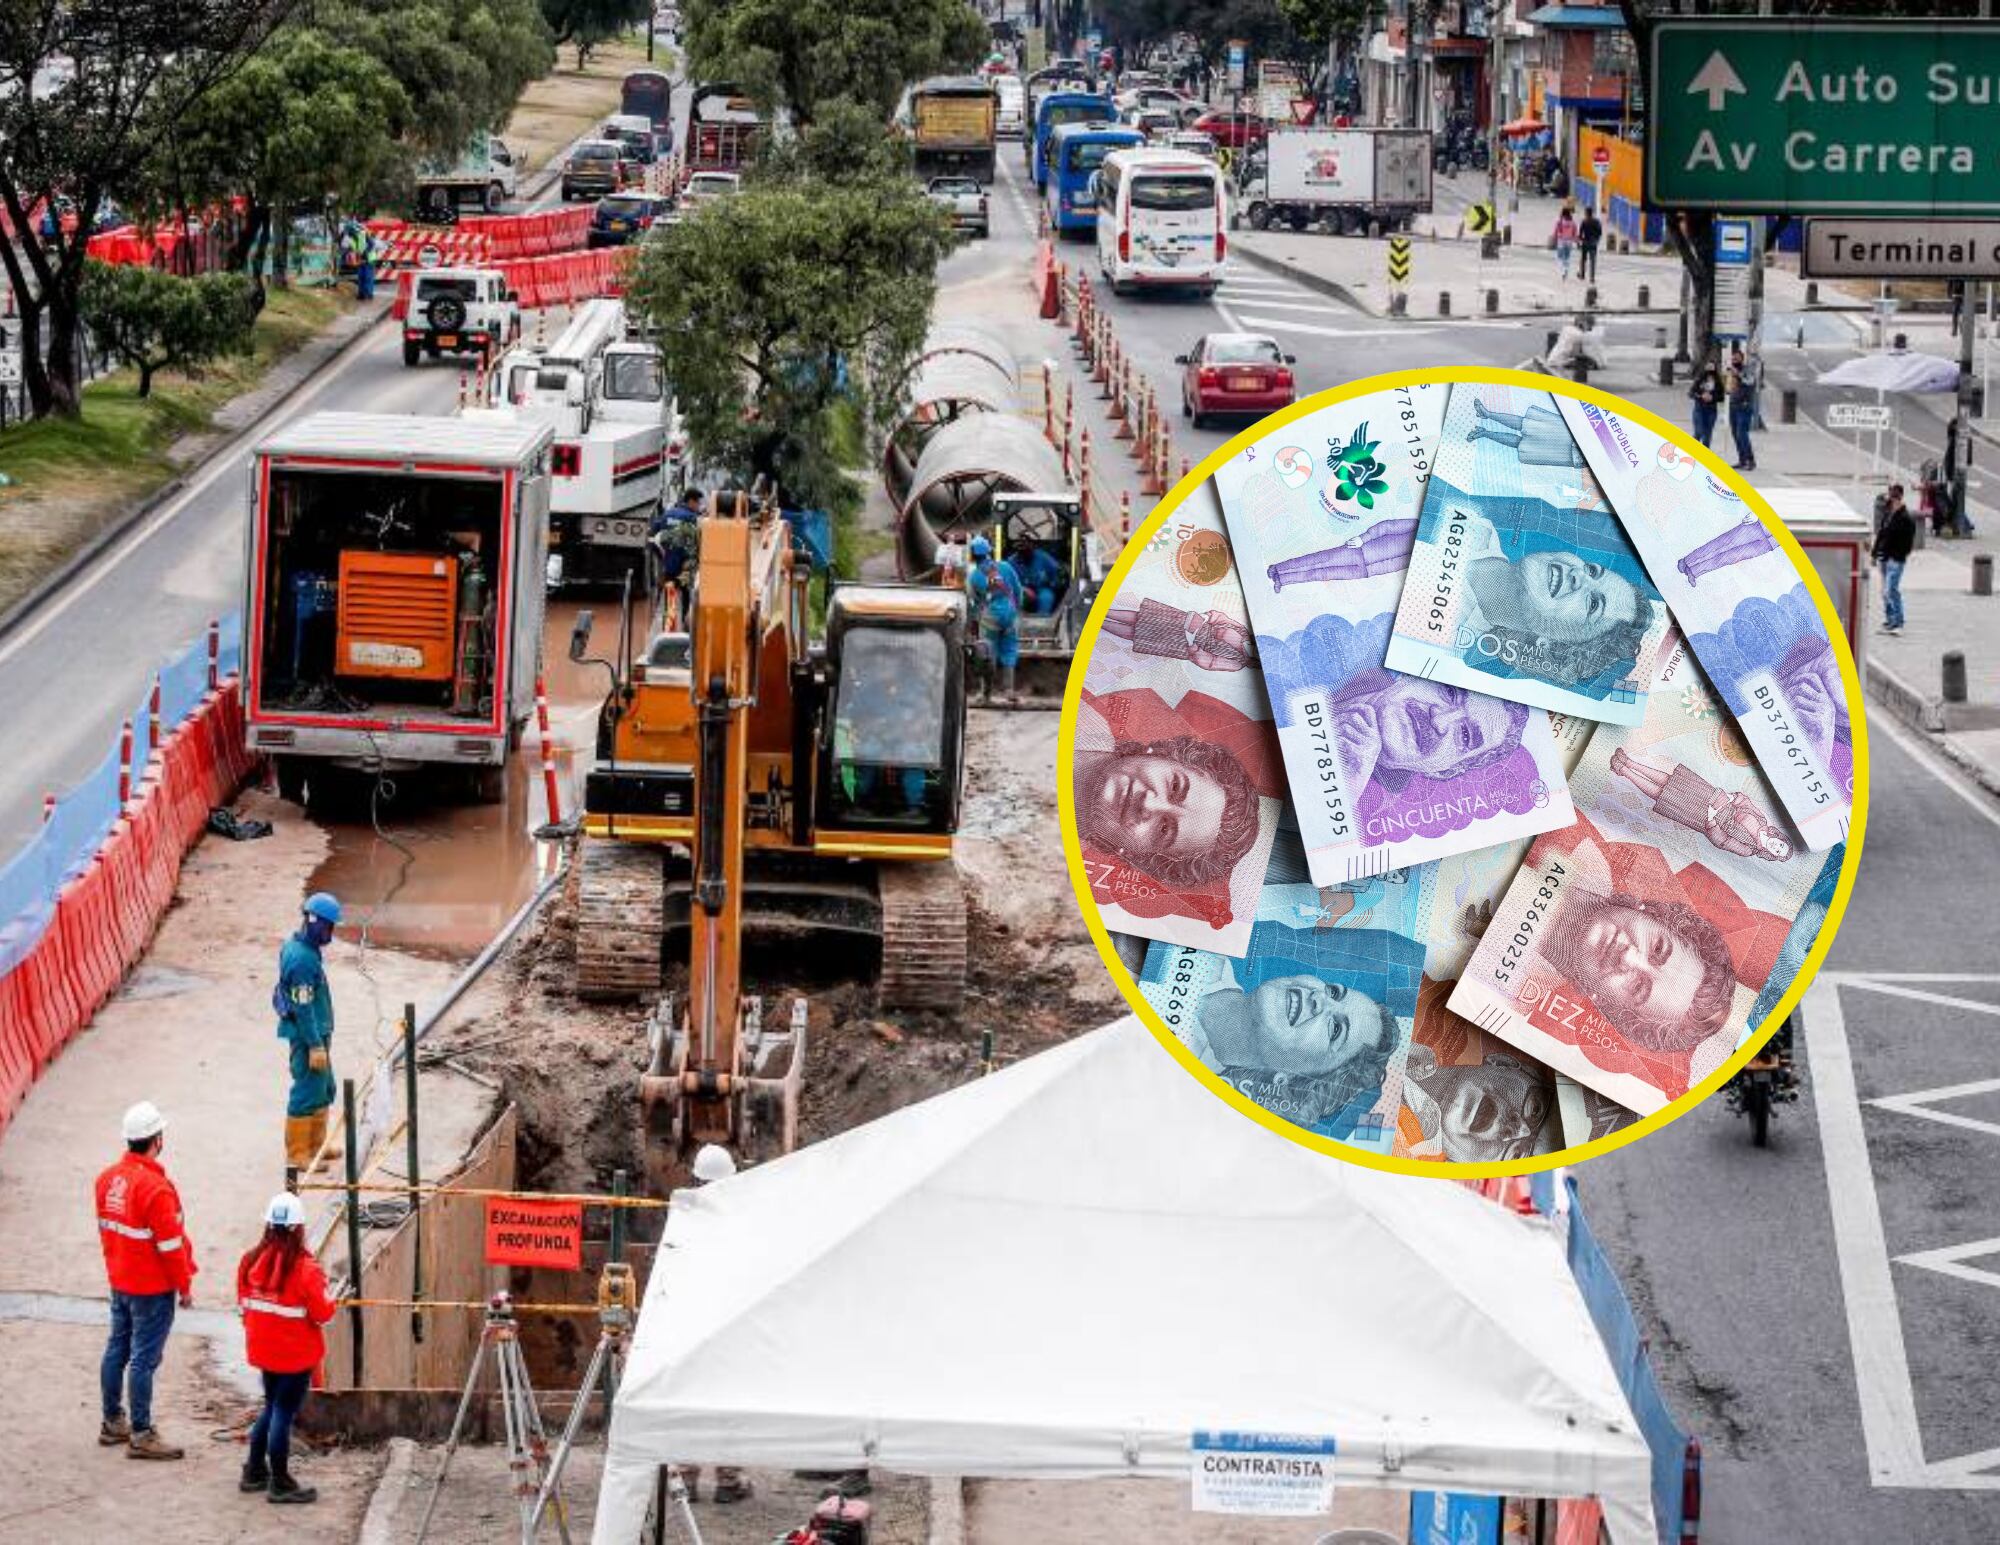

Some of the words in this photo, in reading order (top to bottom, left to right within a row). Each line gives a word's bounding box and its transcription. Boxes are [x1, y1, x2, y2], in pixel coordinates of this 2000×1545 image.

[1776, 60, 1898, 102] Auto
[1927, 62, 2000, 104] Su
[1685, 129, 1756, 171] Av
[1785, 131, 1973, 172] Carrera
[1828, 235, 1975, 263] Terminal
[1608, 416, 1640, 469] REPÚBLICA
[1428, 510, 1467, 632] AG82545065
[1454, 625, 1519, 662] DOS
[1522, 643, 1545, 658] MIL
[1520, 654, 1560, 674] PESOS
[1754, 685, 1830, 805] BD37967155
[1304, 702, 1349, 836] BD77851595
[1366, 795, 1489, 838] CINCUENTA
[1114, 880, 1158, 900] PESOS
[1118, 868, 1142, 883] MIL
[1495, 862, 1566, 983] AC83660255
[1165, 947, 1197, 1037] AG8269
[1516, 979, 1585, 1031] DIEZ
[1580, 1025, 1619, 1054] PESOS
[1585, 1013, 1608, 1033] MIL
[1256, 1096, 1299, 1114] PESOS
[1258, 1081, 1283, 1097] MIL
[497, 1232, 573, 1251] PROFUNDA
[1203, 1455, 1324, 1477] CONTRATISTA
